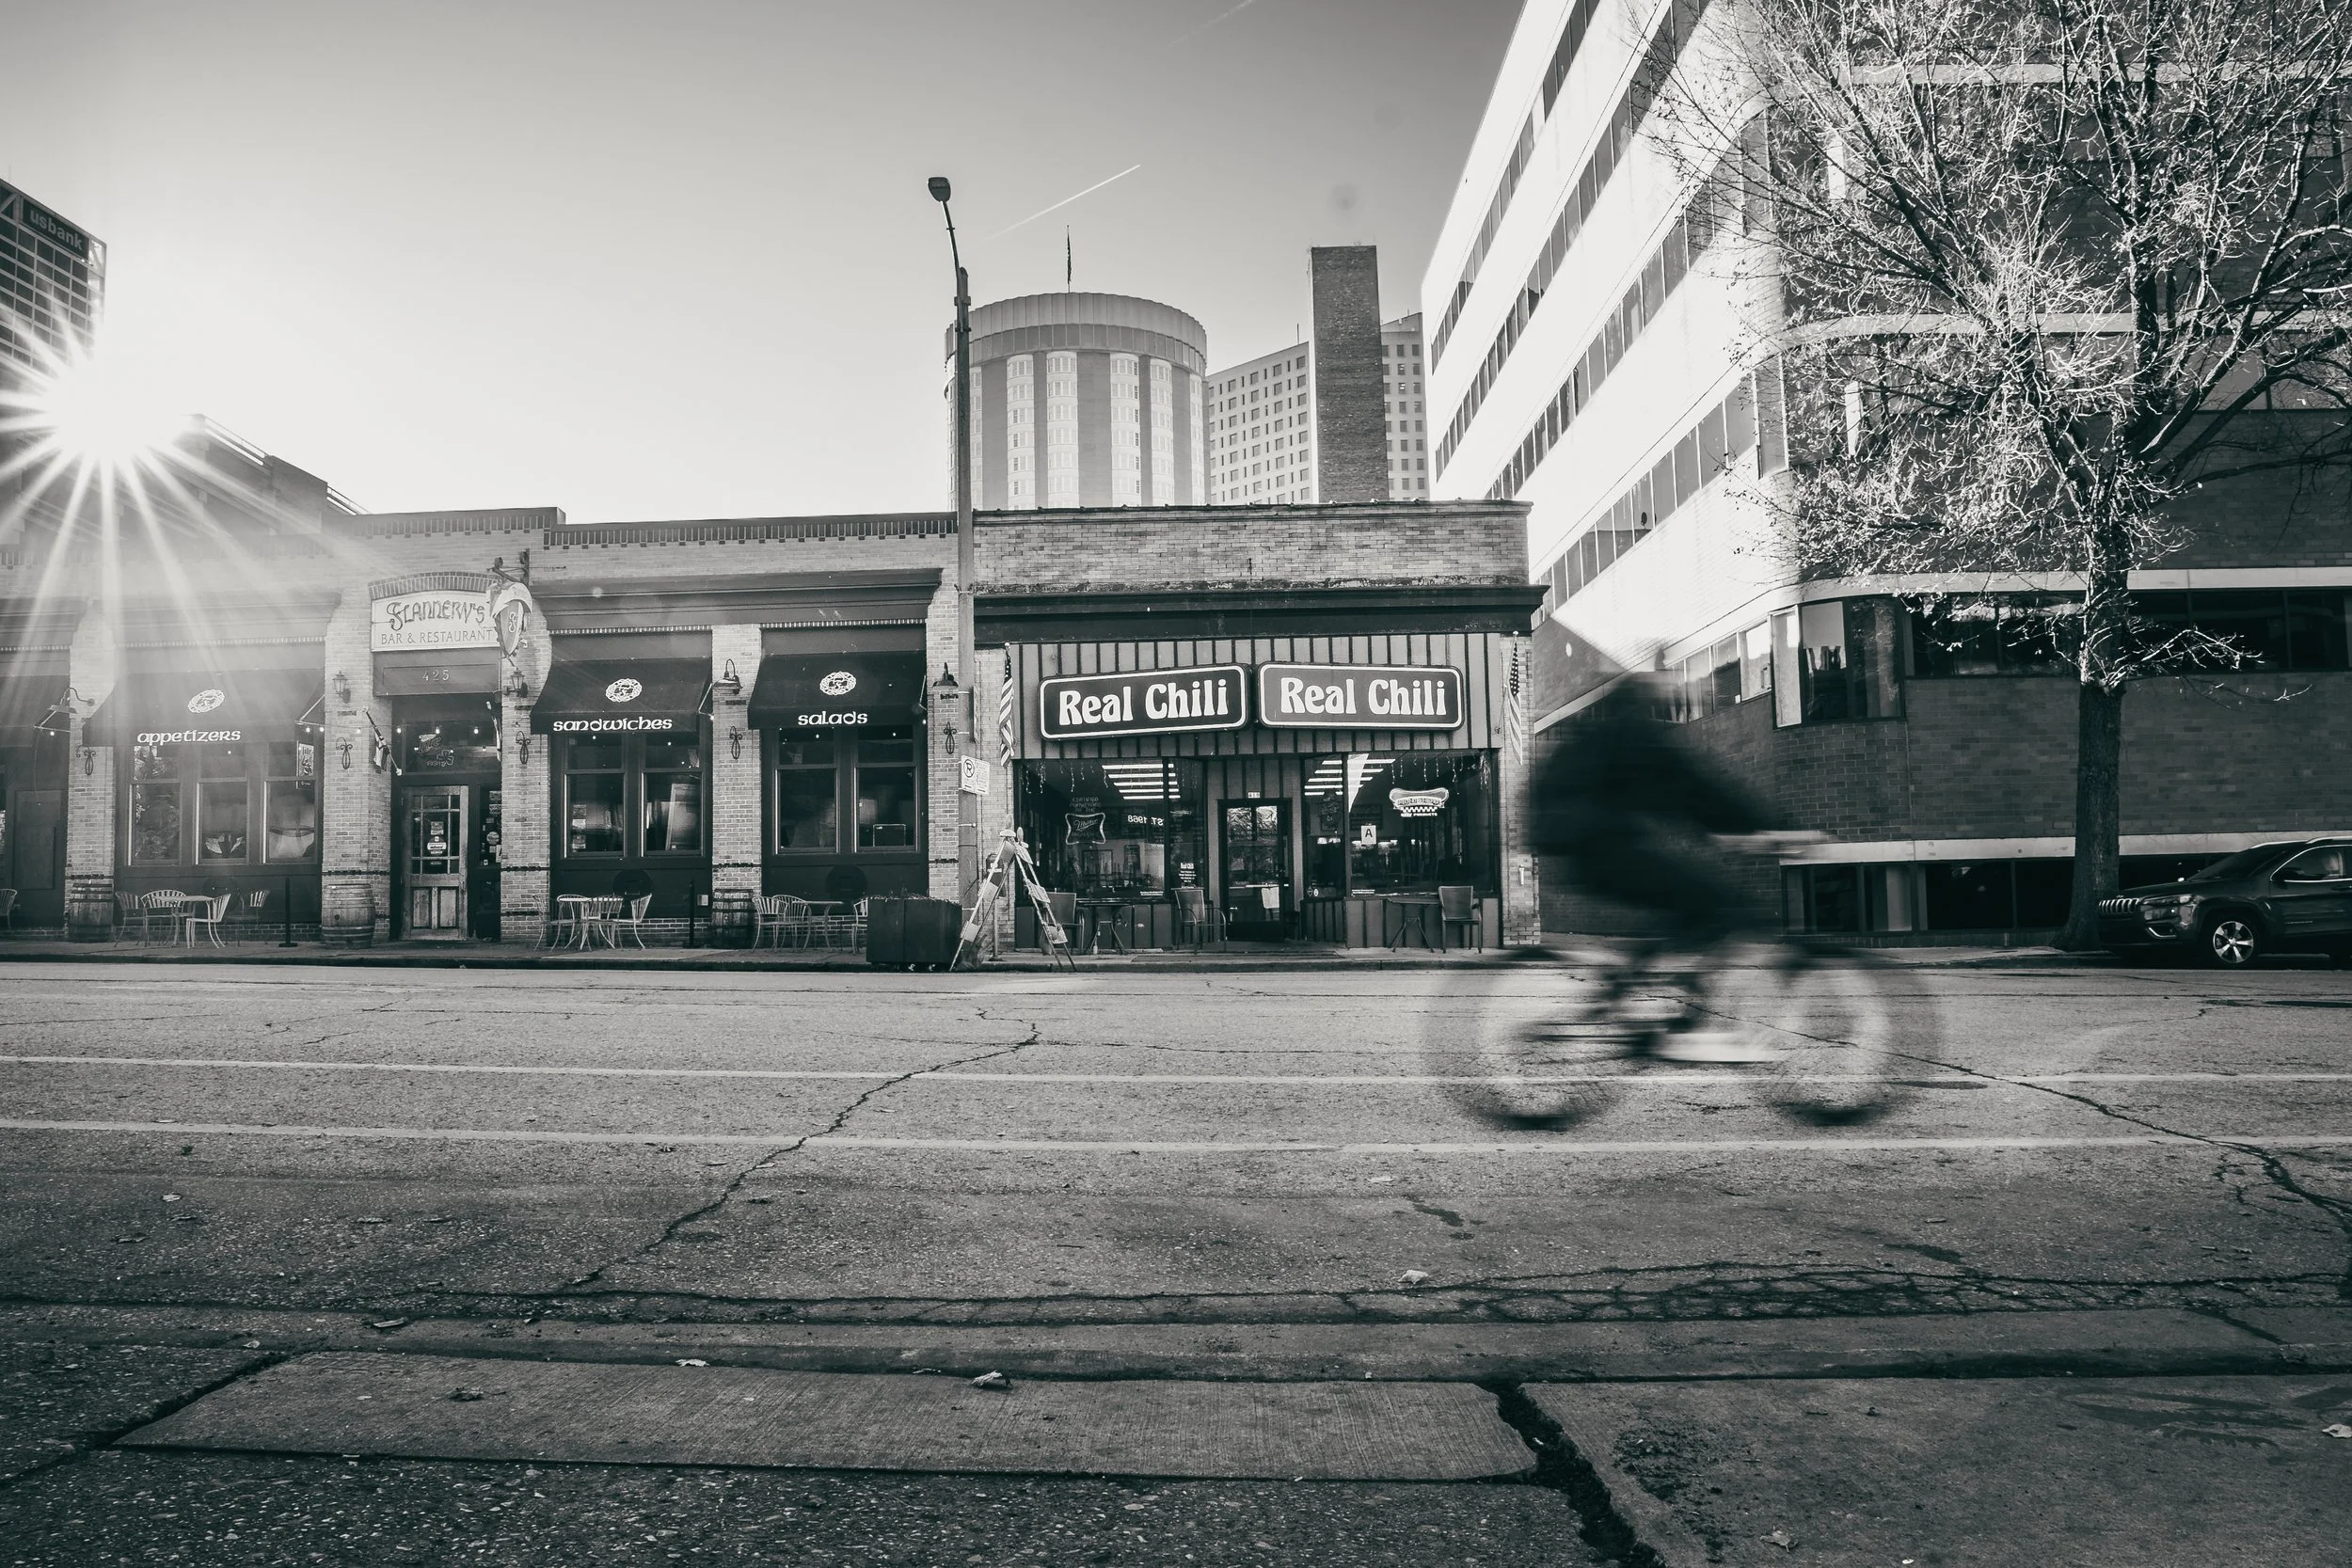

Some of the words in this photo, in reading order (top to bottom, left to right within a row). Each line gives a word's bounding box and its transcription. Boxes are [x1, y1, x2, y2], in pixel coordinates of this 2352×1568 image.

[29, 209, 83, 251] usbank
[387, 600, 485, 631] FLANNERY'S
[381, 633, 403, 645] BAR
[407, 633, 416, 644] &
[420, 629, 493, 643] RESTAURANT
[422, 669, 450, 682] 425
[1058, 686, 1134, 726] Real
[1145, 678, 1229, 720] Chili
[1280, 677, 1357, 715] Real
[1368, 678, 1447, 716] Chili
[552, 716, 673, 732] sandwiches
[798, 710, 868, 726] salads
[136, 729, 242, 746] appetizers
[1365, 829, 1374, 838] A
